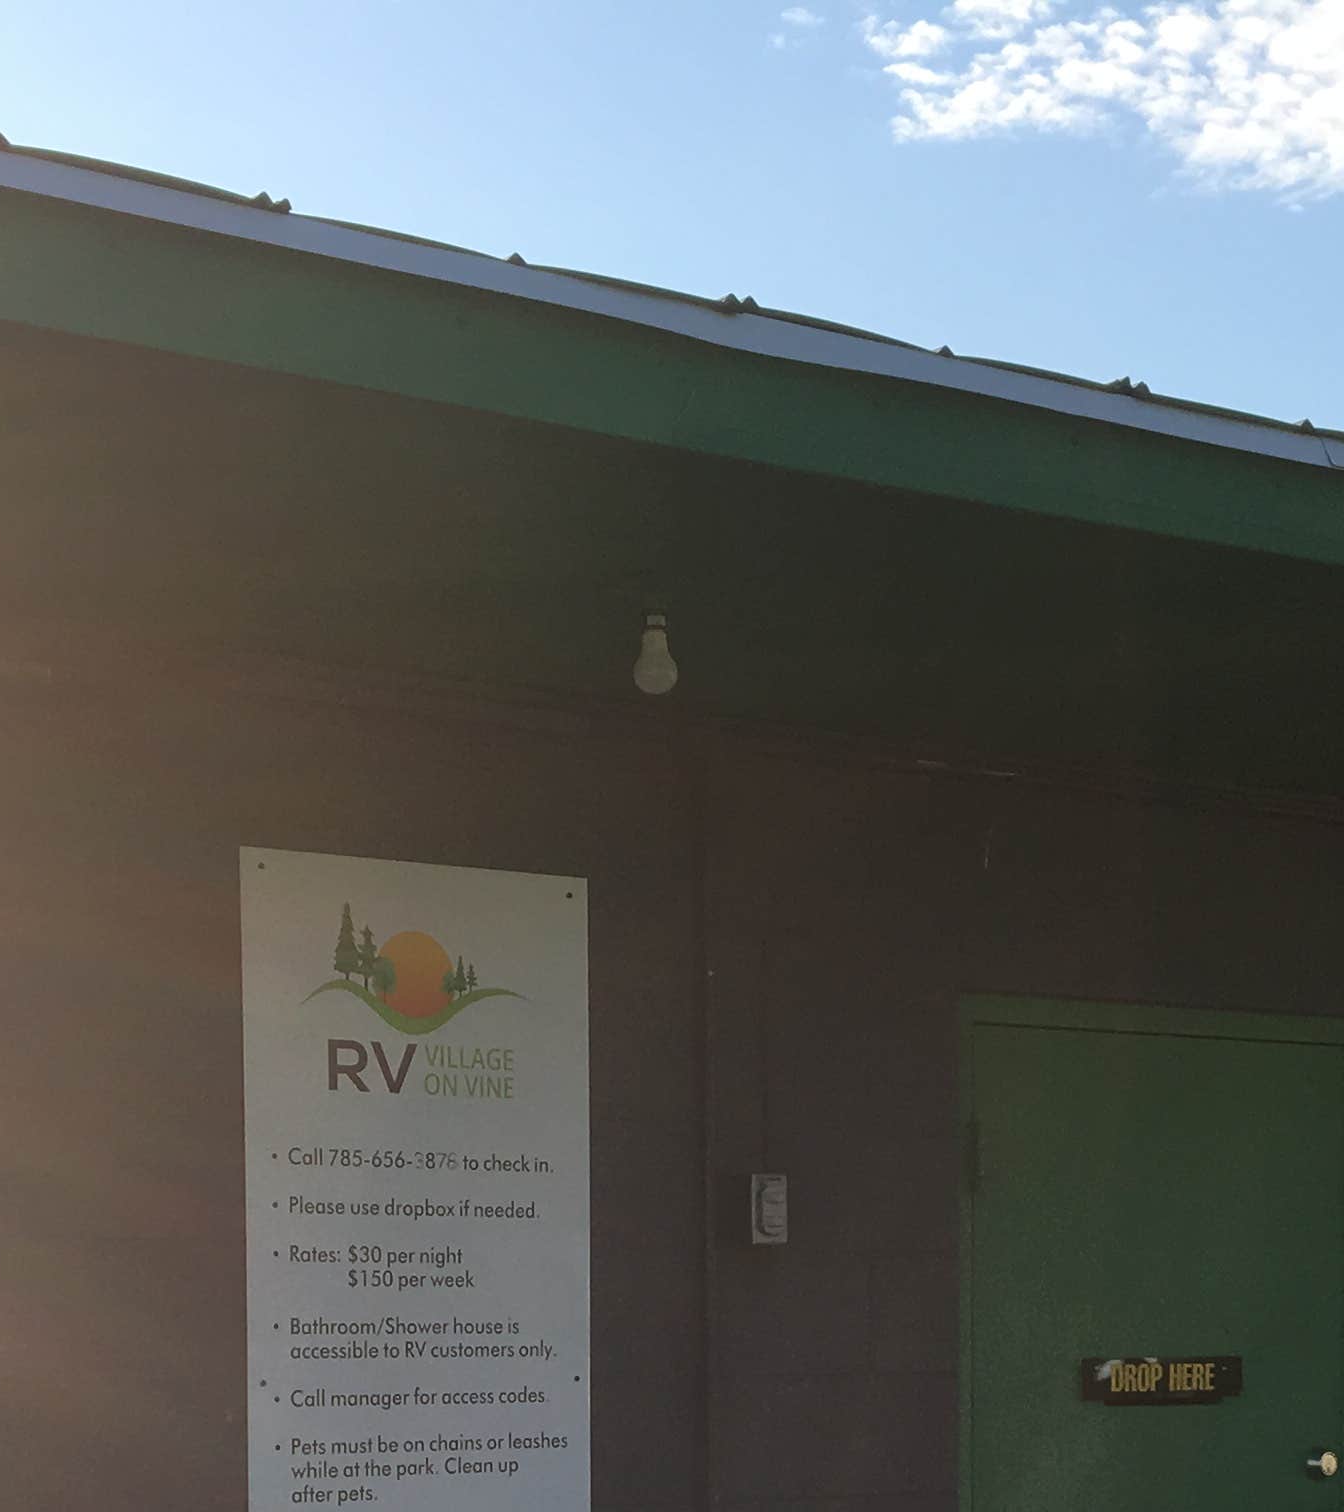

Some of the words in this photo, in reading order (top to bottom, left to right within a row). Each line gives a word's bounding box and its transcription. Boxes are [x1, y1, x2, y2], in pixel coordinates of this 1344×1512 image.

[328, 1039, 417, 1094] RV
[425, 1044, 514, 1072] VILLAGE
[424, 1073, 457, 1096] ON
[464, 1074, 514, 1099] VINE
[288, 1147, 323, 1165] Call
[463, 1156, 479, 1170] to
[484, 1153, 530, 1172] check
[535, 1157, 553, 1173] in.
[290, 1196, 345, 1214] Please
[351, 1203, 379, 1215] use
[385, 1198, 455, 1221] dropbox
[459, 1200, 470, 1216] if
[474, 1201, 539, 1218] needed.
[290, 1245, 341, 1263] Rates:
[348, 1245, 381, 1264] $30
[387, 1252, 415, 1268] per
[420, 1246, 462, 1268] night
[348, 1269, 393, 1288] $150
[398, 1276, 426, 1291] per
[430, 1270, 474, 1288] week
[291, 1316, 449, 1336] Bathroom/Shower
[453, 1317, 503, 1334] house
[508, 1318, 519, 1334] is
[291, 1340, 379, 1359] accessible
[383, 1343, 400, 1358] to
[405, 1341, 426, 1358] RV
[431, 1343, 514, 1358] customers
[519, 1339, 557, 1360] only.
[1111, 1363, 1163, 1392] DROP
[1169, 1362, 1216, 1391] HERE
[291, 1389, 325, 1407] Call
[331, 1394, 410, 1410] manager
[414, 1387, 437, 1405] for
[442, 1392, 494, 1404] access
[292, 1438, 326, 1455] Pets
[332, 1438, 373, 1454] must
[378, 1435, 398, 1453] be
[403, 1440, 424, 1452] on
[429, 1433, 482, 1451] chains
[487, 1439, 504, 1450] or
[509, 1432, 568, 1449] leashes
[291, 1460, 338, 1479] while
[343, 1462, 360, 1477] at
[365, 1459, 391, 1477] the
[397, 1457, 438, 1480] park.
[445, 1456, 493, 1474] Clean
[498, 1461, 518, 1477] up
[292, 1484, 333, 1503] after
[338, 1486, 377, 1506] pets.
